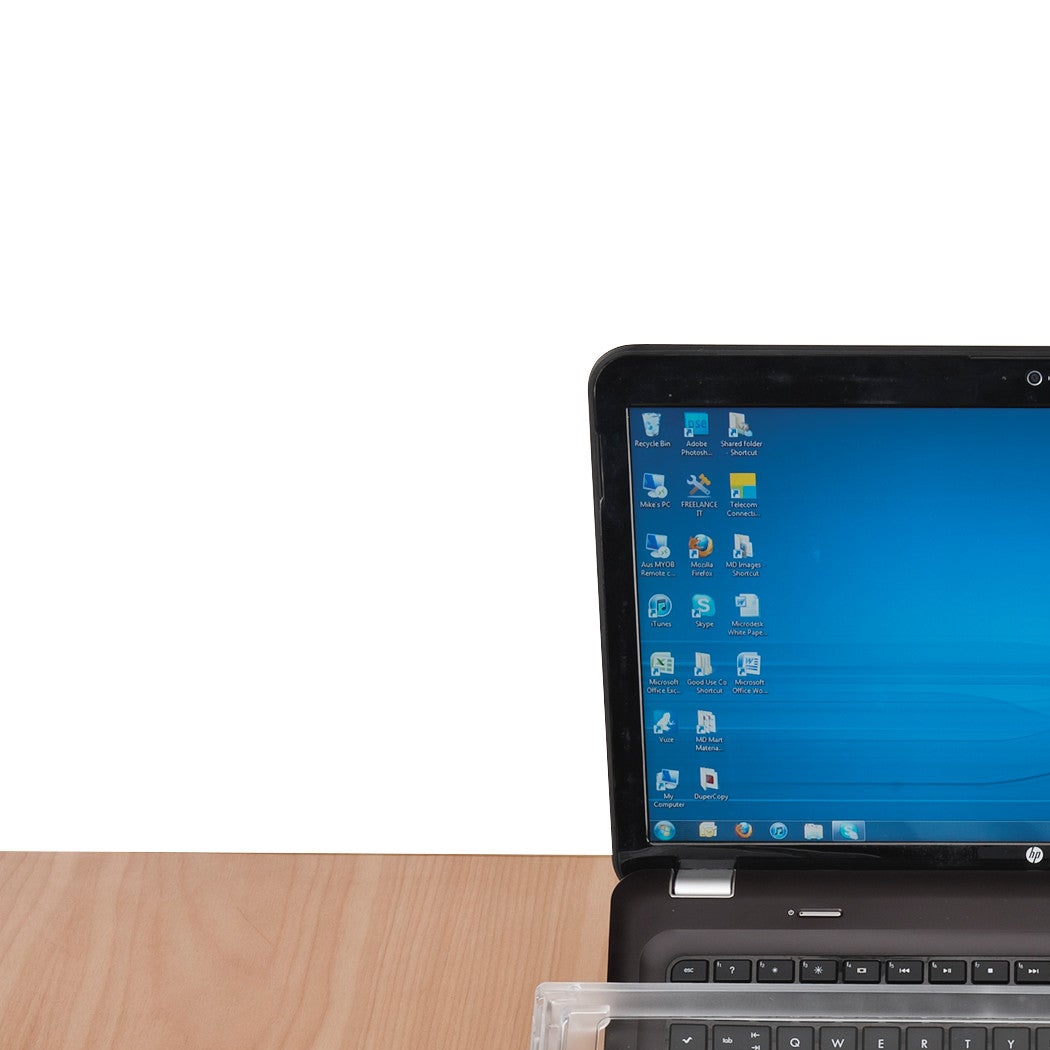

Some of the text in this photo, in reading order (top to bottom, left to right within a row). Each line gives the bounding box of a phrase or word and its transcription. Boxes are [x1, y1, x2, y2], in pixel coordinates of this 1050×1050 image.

[635, 440, 659, 448] Recycle
[694, 793, 728, 801] DuperCopy
[1029, 846, 1041, 864] hp
